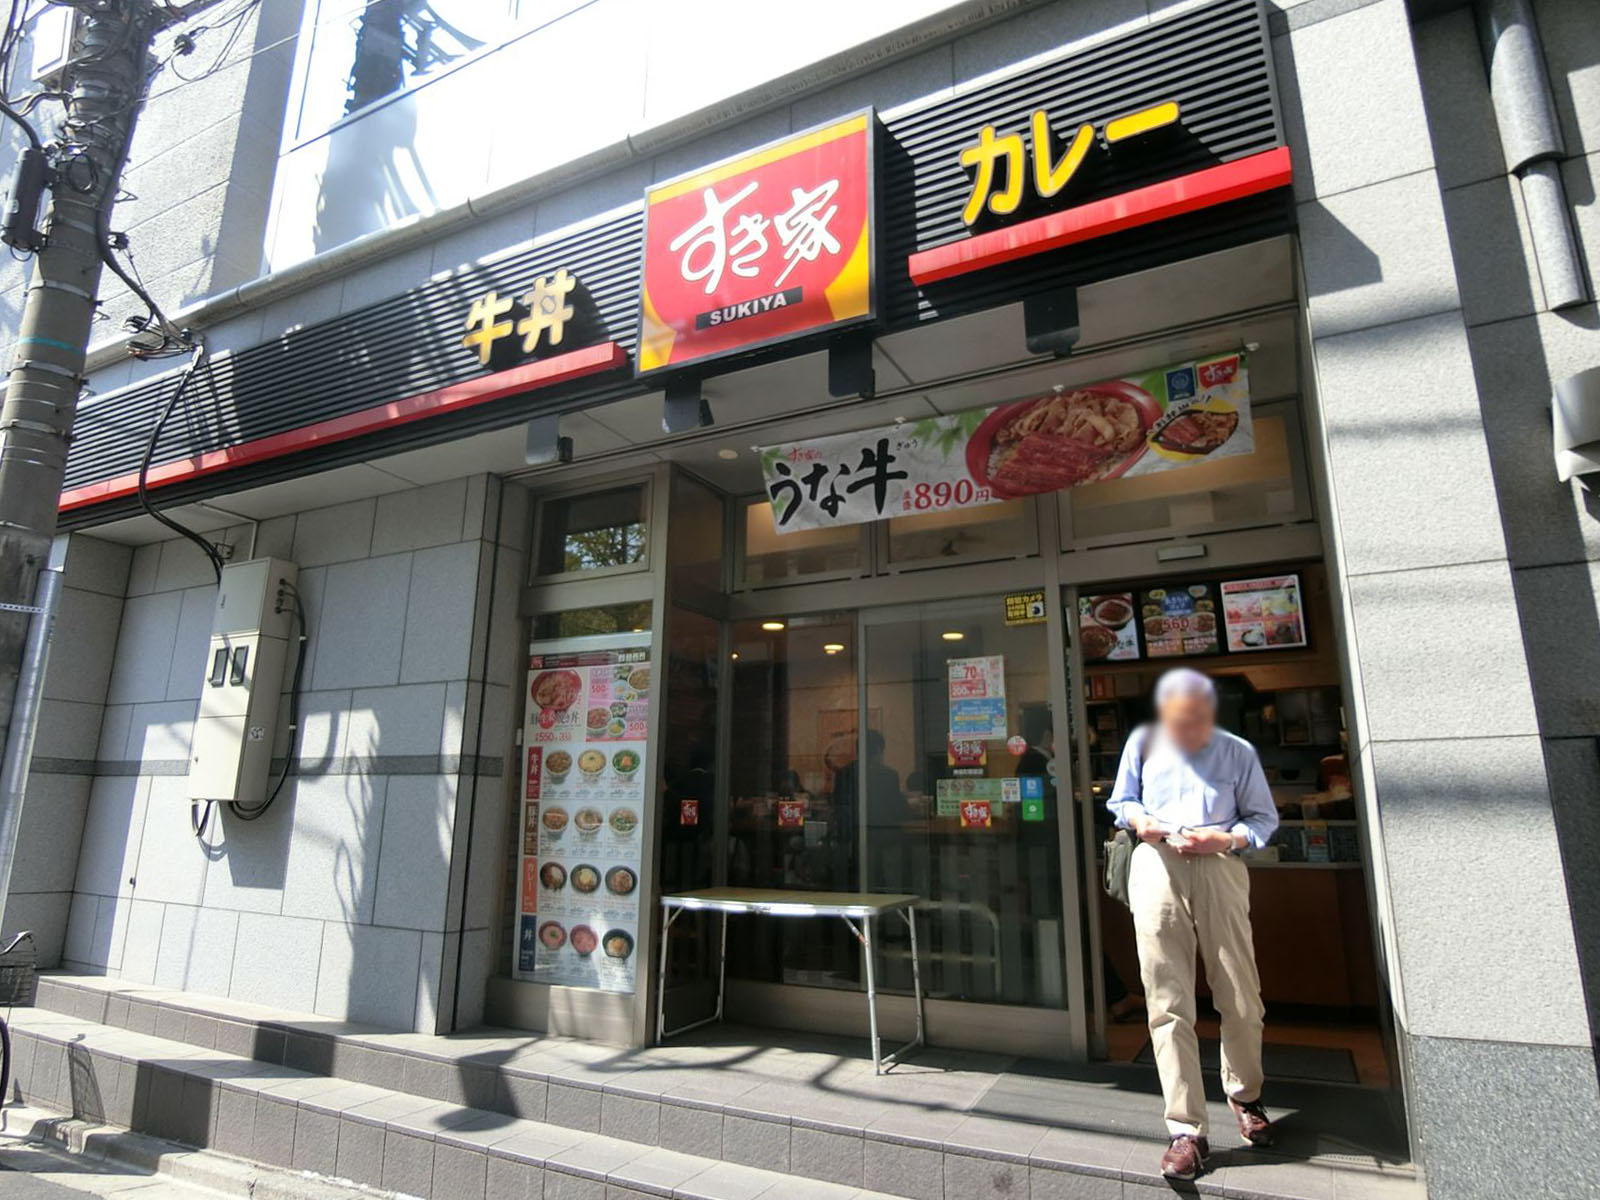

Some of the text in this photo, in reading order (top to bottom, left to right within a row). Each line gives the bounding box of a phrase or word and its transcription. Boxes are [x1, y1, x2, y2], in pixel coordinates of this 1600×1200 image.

[959, 100, 1180, 226] カレー
[669, 179, 841, 295] すき家
[462, 266, 577, 366] 牛丼
[709, 293, 787, 325] SUKIYA
[769, 437, 909, 527] うな牛
[914, 478, 990, 510] 890円
